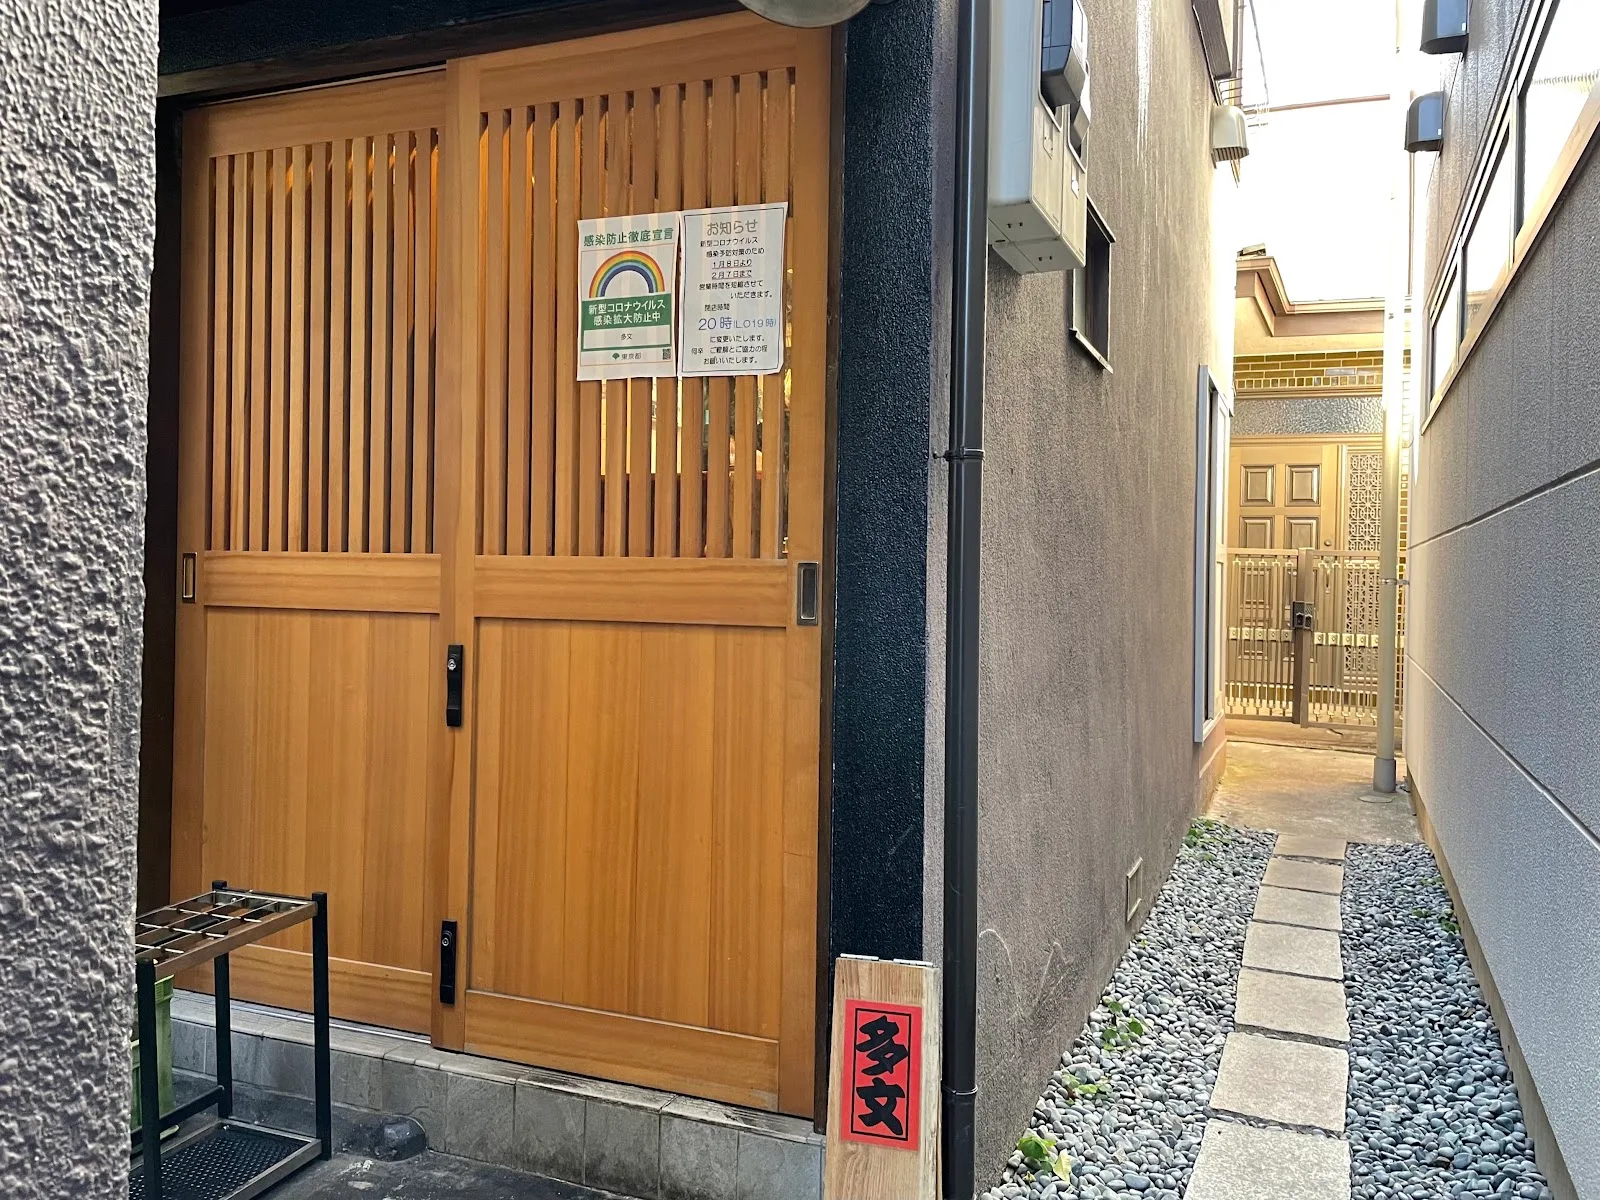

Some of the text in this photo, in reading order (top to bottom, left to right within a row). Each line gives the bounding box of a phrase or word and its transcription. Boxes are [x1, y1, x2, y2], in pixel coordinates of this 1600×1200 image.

[706, 219, 758, 236] お知らせ
[583, 227, 674, 247] 感染防止徹底宣言
[700, 236, 759, 248] 新型コロナウイルス
[588, 299, 666, 315] 新型コロナウイルス
[593, 311, 661, 326] 感染拡大防止中
[620, 333, 633, 341] 多文
[621, 352, 642, 361] 東京都
[855, 1014, 909, 1136] 多文
